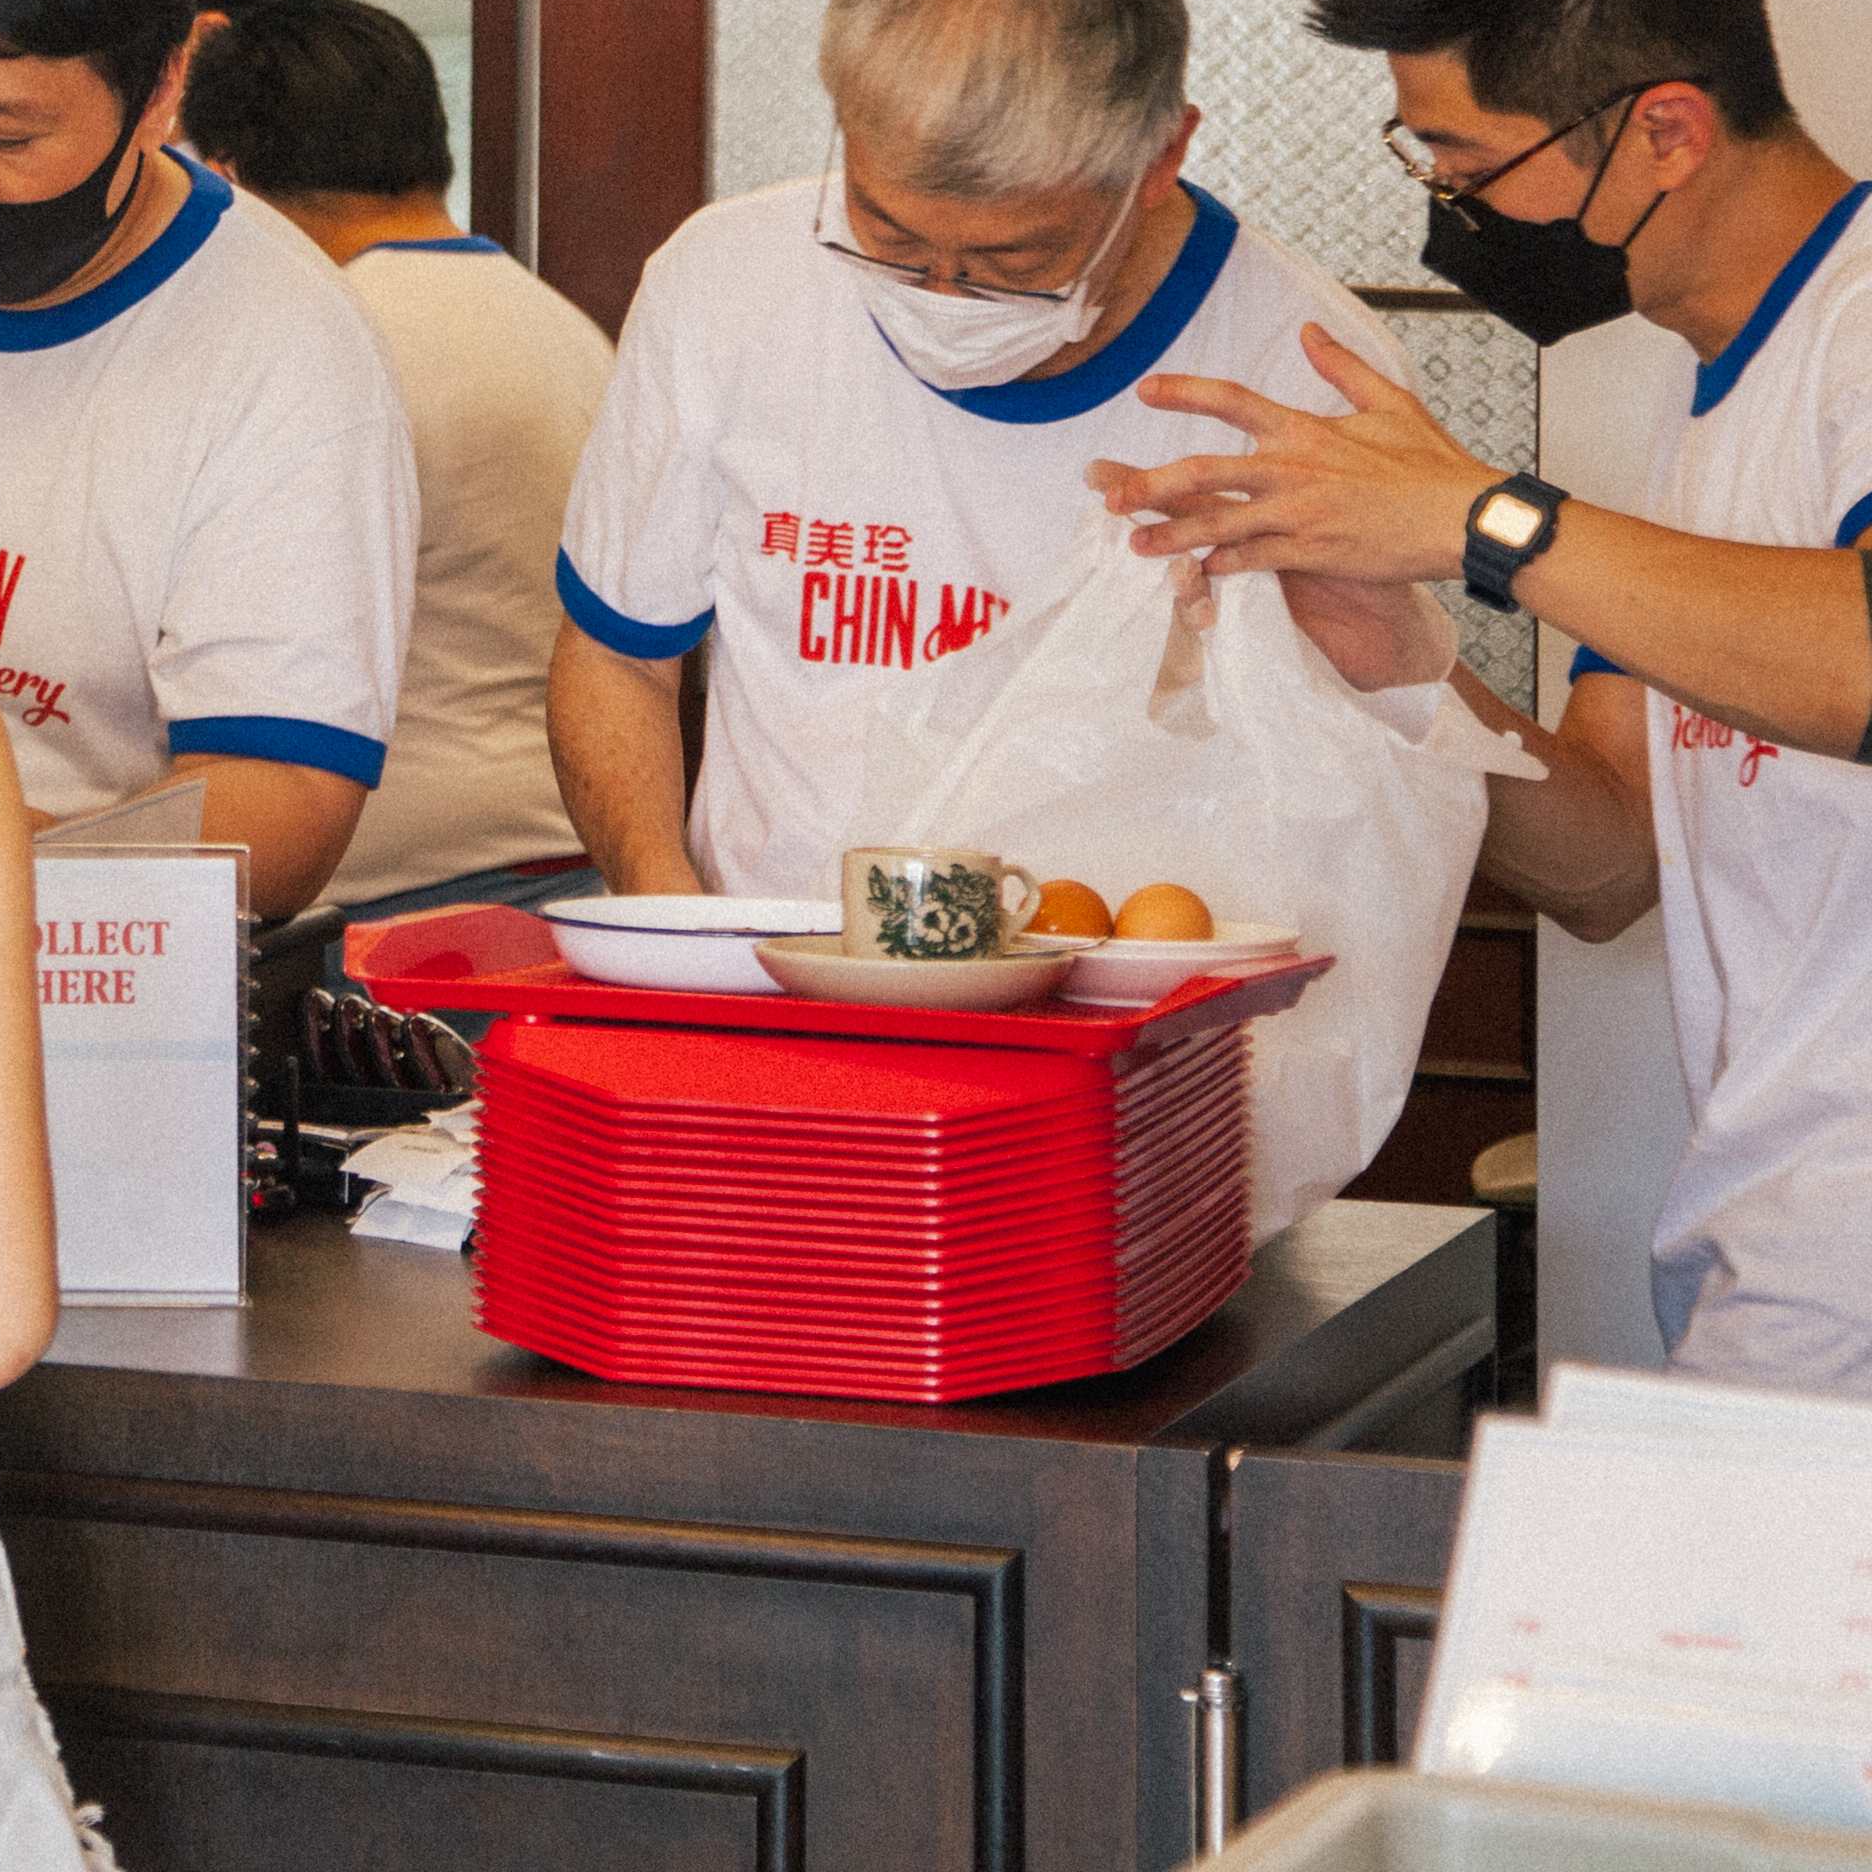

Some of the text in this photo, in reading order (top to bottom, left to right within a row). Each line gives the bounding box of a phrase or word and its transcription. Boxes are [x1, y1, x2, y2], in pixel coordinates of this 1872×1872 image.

[760, 511, 913, 573] 真美珍
[798, 571, 917, 671] CHIN
